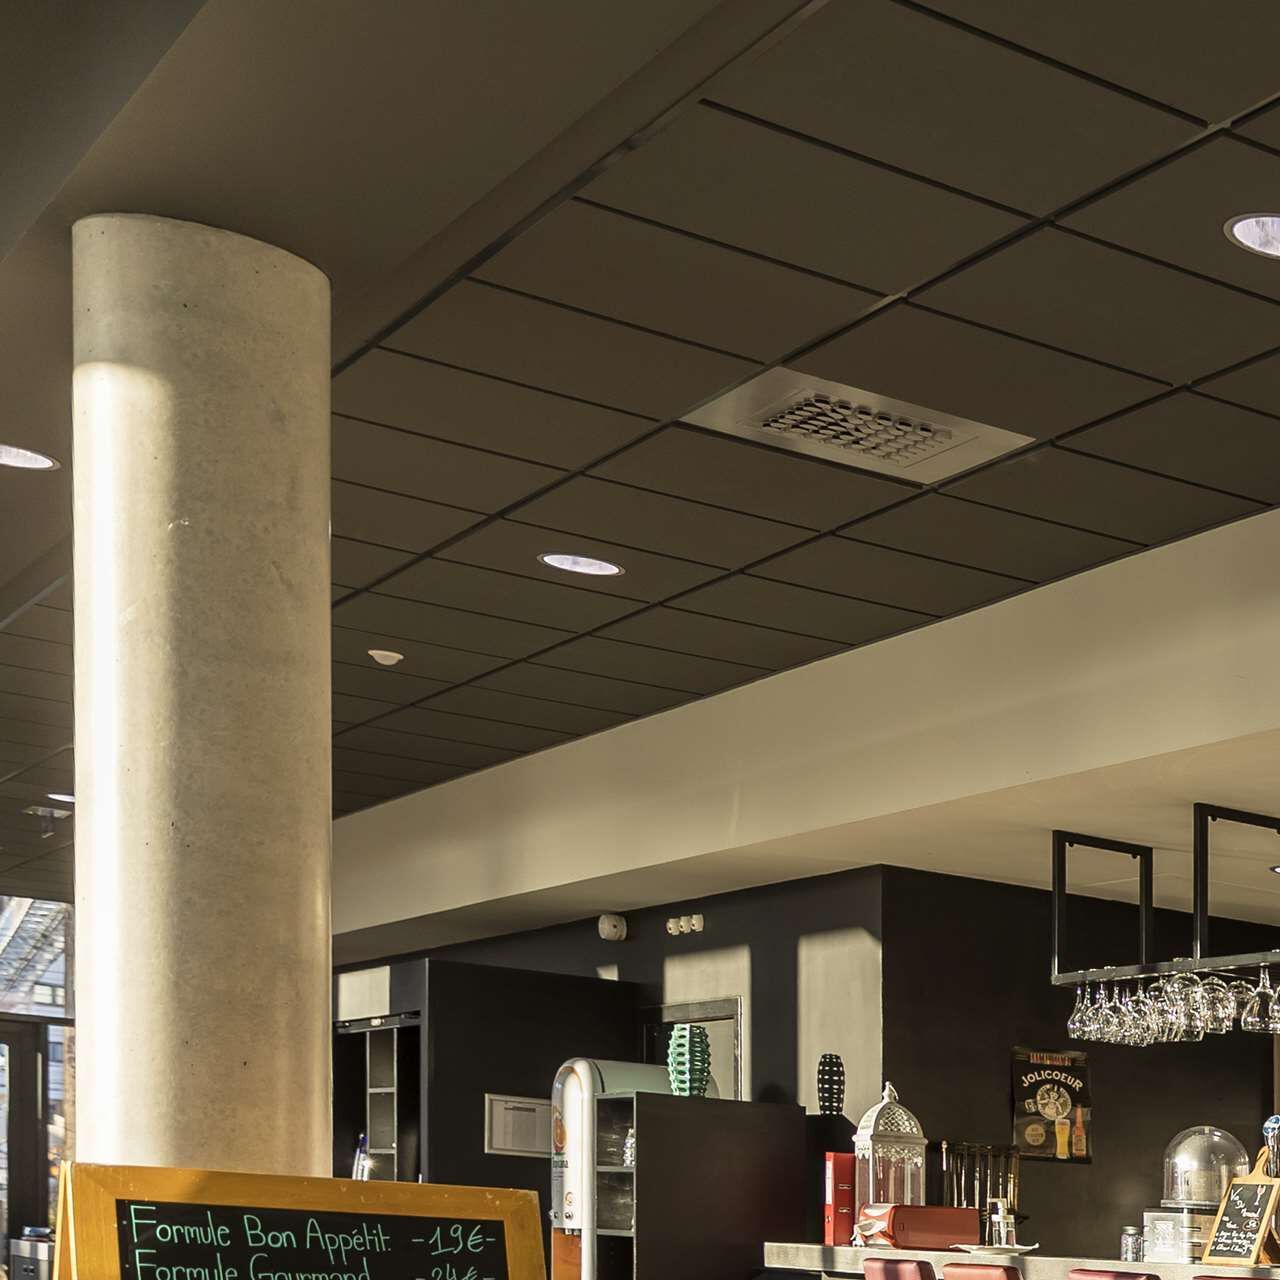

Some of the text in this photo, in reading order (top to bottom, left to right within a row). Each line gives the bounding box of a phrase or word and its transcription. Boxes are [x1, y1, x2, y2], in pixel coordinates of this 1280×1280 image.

[1021, 1070, 1083, 1092] JOLICOEUR
[130, 1205, 231, 1247] Formule
[243, 1215, 297, 1248] Bon
